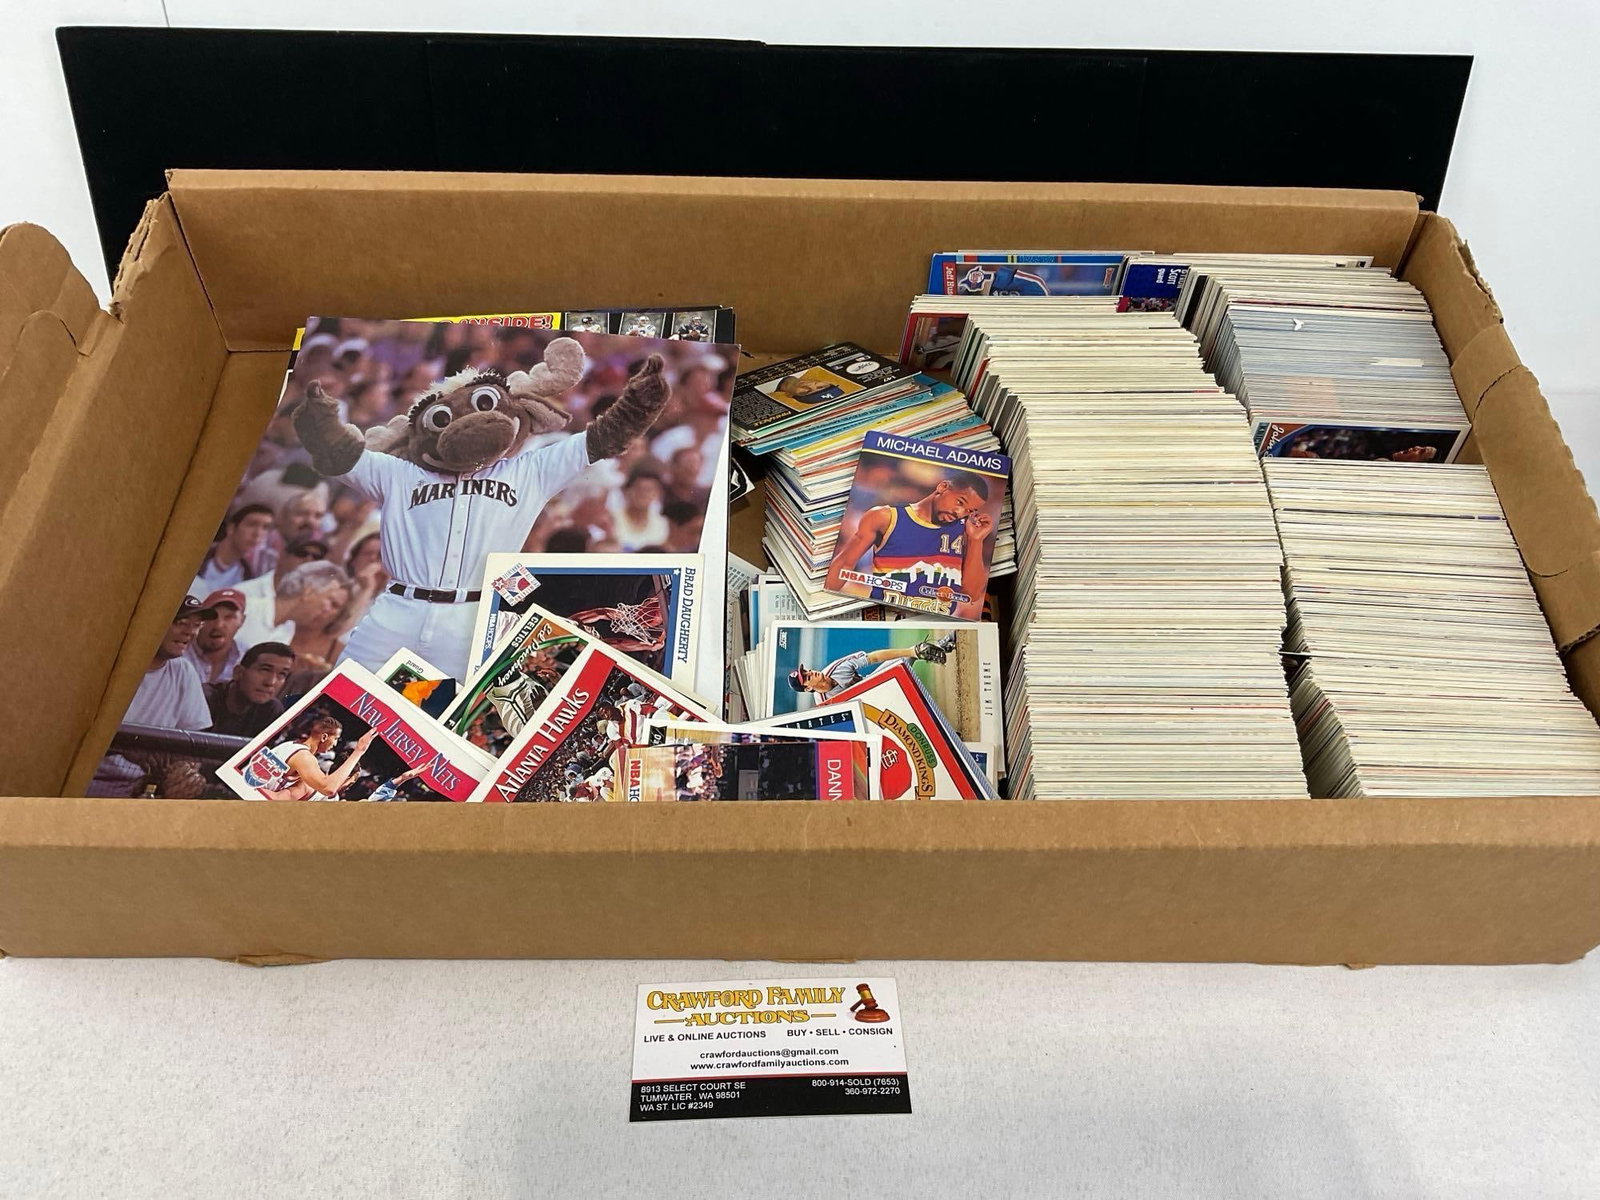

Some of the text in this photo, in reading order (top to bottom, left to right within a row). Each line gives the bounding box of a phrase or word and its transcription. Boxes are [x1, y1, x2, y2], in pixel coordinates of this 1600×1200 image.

[877, 437, 1002, 470] MICHAEL ADAMS
[408, 479, 518, 510] MARINERS
[940, 533, 962, 554] 14
[677, 566, 696, 663] BRAD DAUGHERTY
[511, 616, 540, 648] CELTICS
[405, 660, 424, 674] Guard
[350, 691, 461, 792] NEW JERSEY NETS
[495, 688, 590, 802] ATLANTA HAWKS
[910, 726, 934, 764] DONRUSS
[884, 713, 921, 757] DIAMOND
[916, 758, 933, 792] KINGS
[646, 986, 846, 1012] CRAWFORD FAMILY
[684, 1009, 811, 1027] AUCTIONS
[644, 1030, 767, 1043] LIVE & ONLINE AUCTIONS
[787, 1027, 893, 1037] BUY SELL CONSIGN
[700, 1048, 839, 1059] crawfordauctions@gmail.com
[690, 1058, 849, 1070] www.crawfordfamilyauctions.com
[640, 1081, 747, 1094] 8913 SELECT COURT SE
[811, 1077, 900, 1087] 800-914-SOLD (7653)
[845, 1086, 901, 1096] 360-972-2270
[698, 1091, 714, 1100] WA
[715, 1090, 740, 1099] 98501
[640, 1103, 655, 1112] WA
[671, 1102, 686, 1111] LIC
[688, 1101, 714, 1110] #2349
